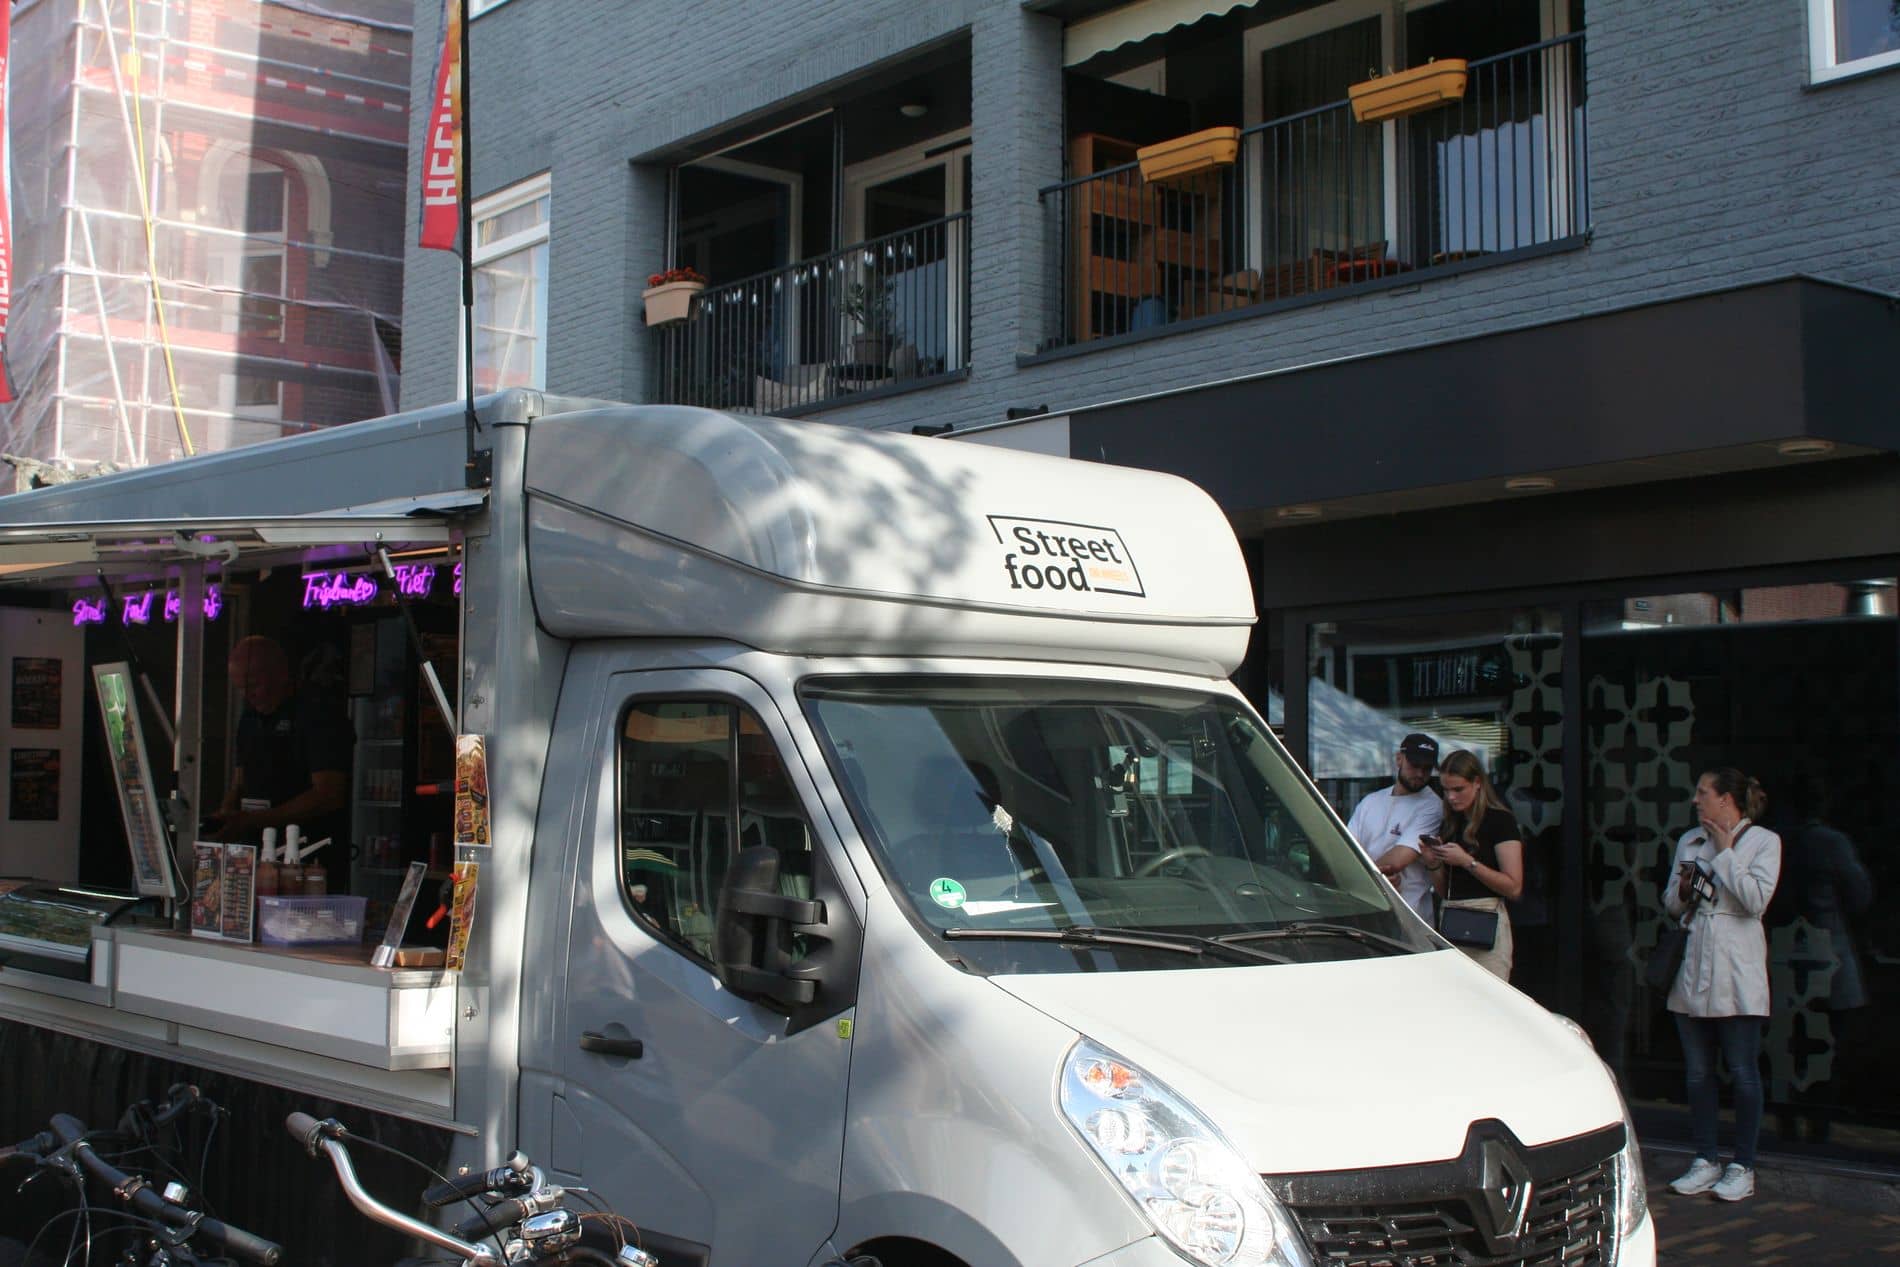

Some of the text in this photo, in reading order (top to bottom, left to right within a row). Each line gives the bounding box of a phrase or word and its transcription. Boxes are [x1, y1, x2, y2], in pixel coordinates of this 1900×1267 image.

[1012, 526, 1122, 565] Street
[1004, 553, 1092, 592] food
[942, 879, 952, 894] 4
